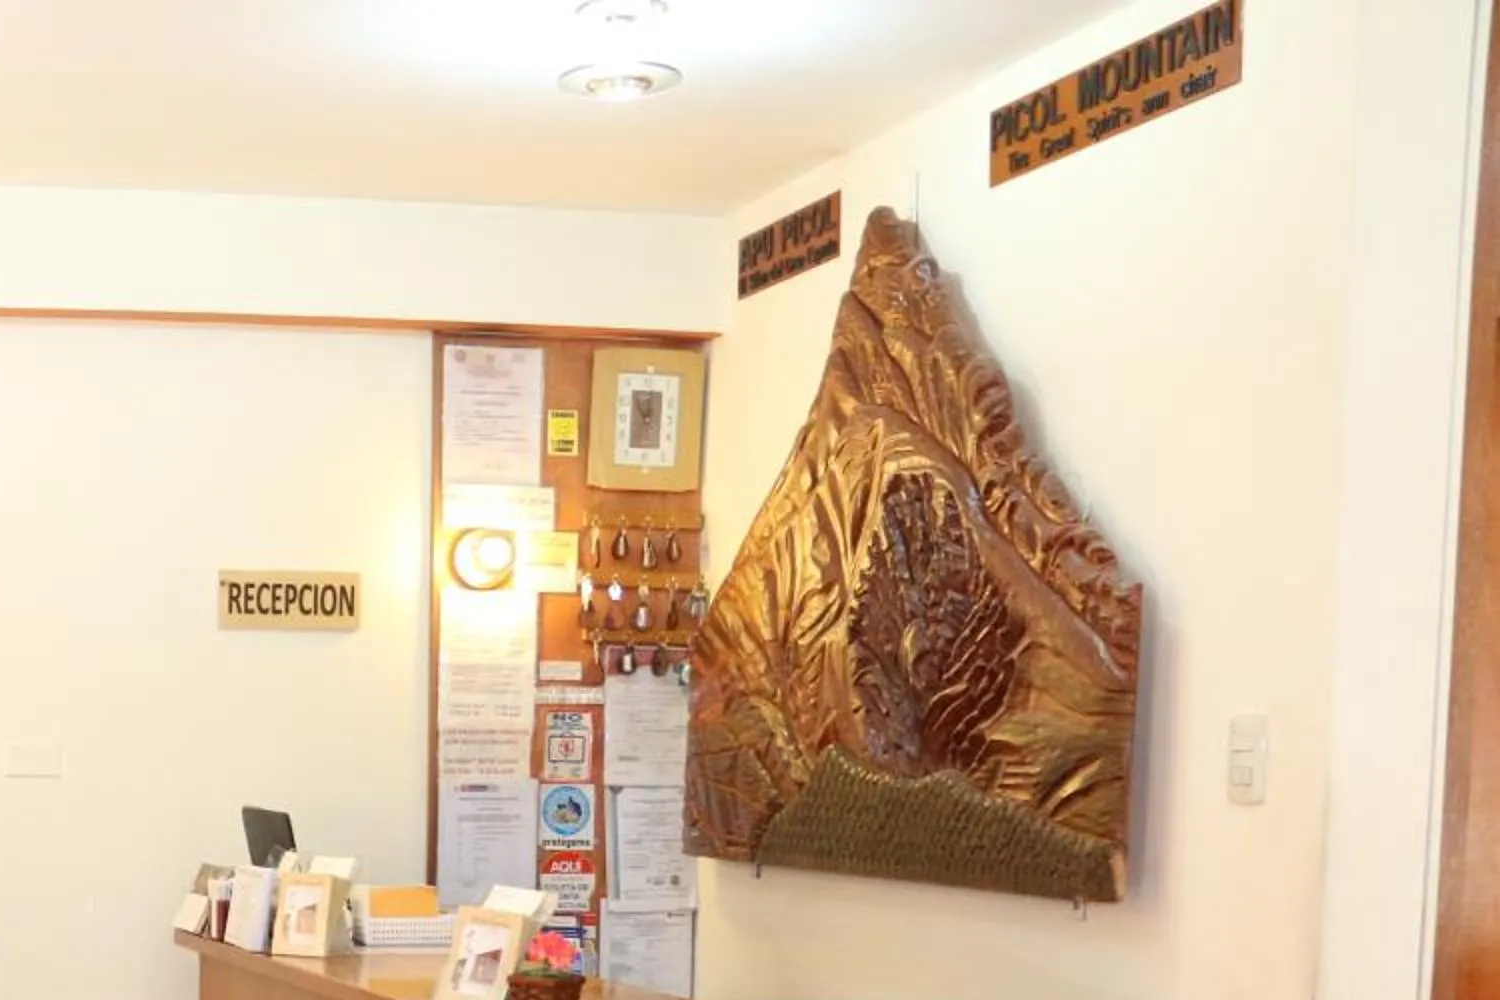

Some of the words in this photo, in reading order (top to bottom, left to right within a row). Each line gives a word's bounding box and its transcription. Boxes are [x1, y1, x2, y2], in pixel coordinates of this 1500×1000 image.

[990, 84, 1067, 153] PICOL
[1077, 1, 1234, 113] MOUNTAIN
[739, 225, 774, 272] APU
[781, 199, 837, 254] PICOL
[227, 581, 356, 617] RECEPCION
